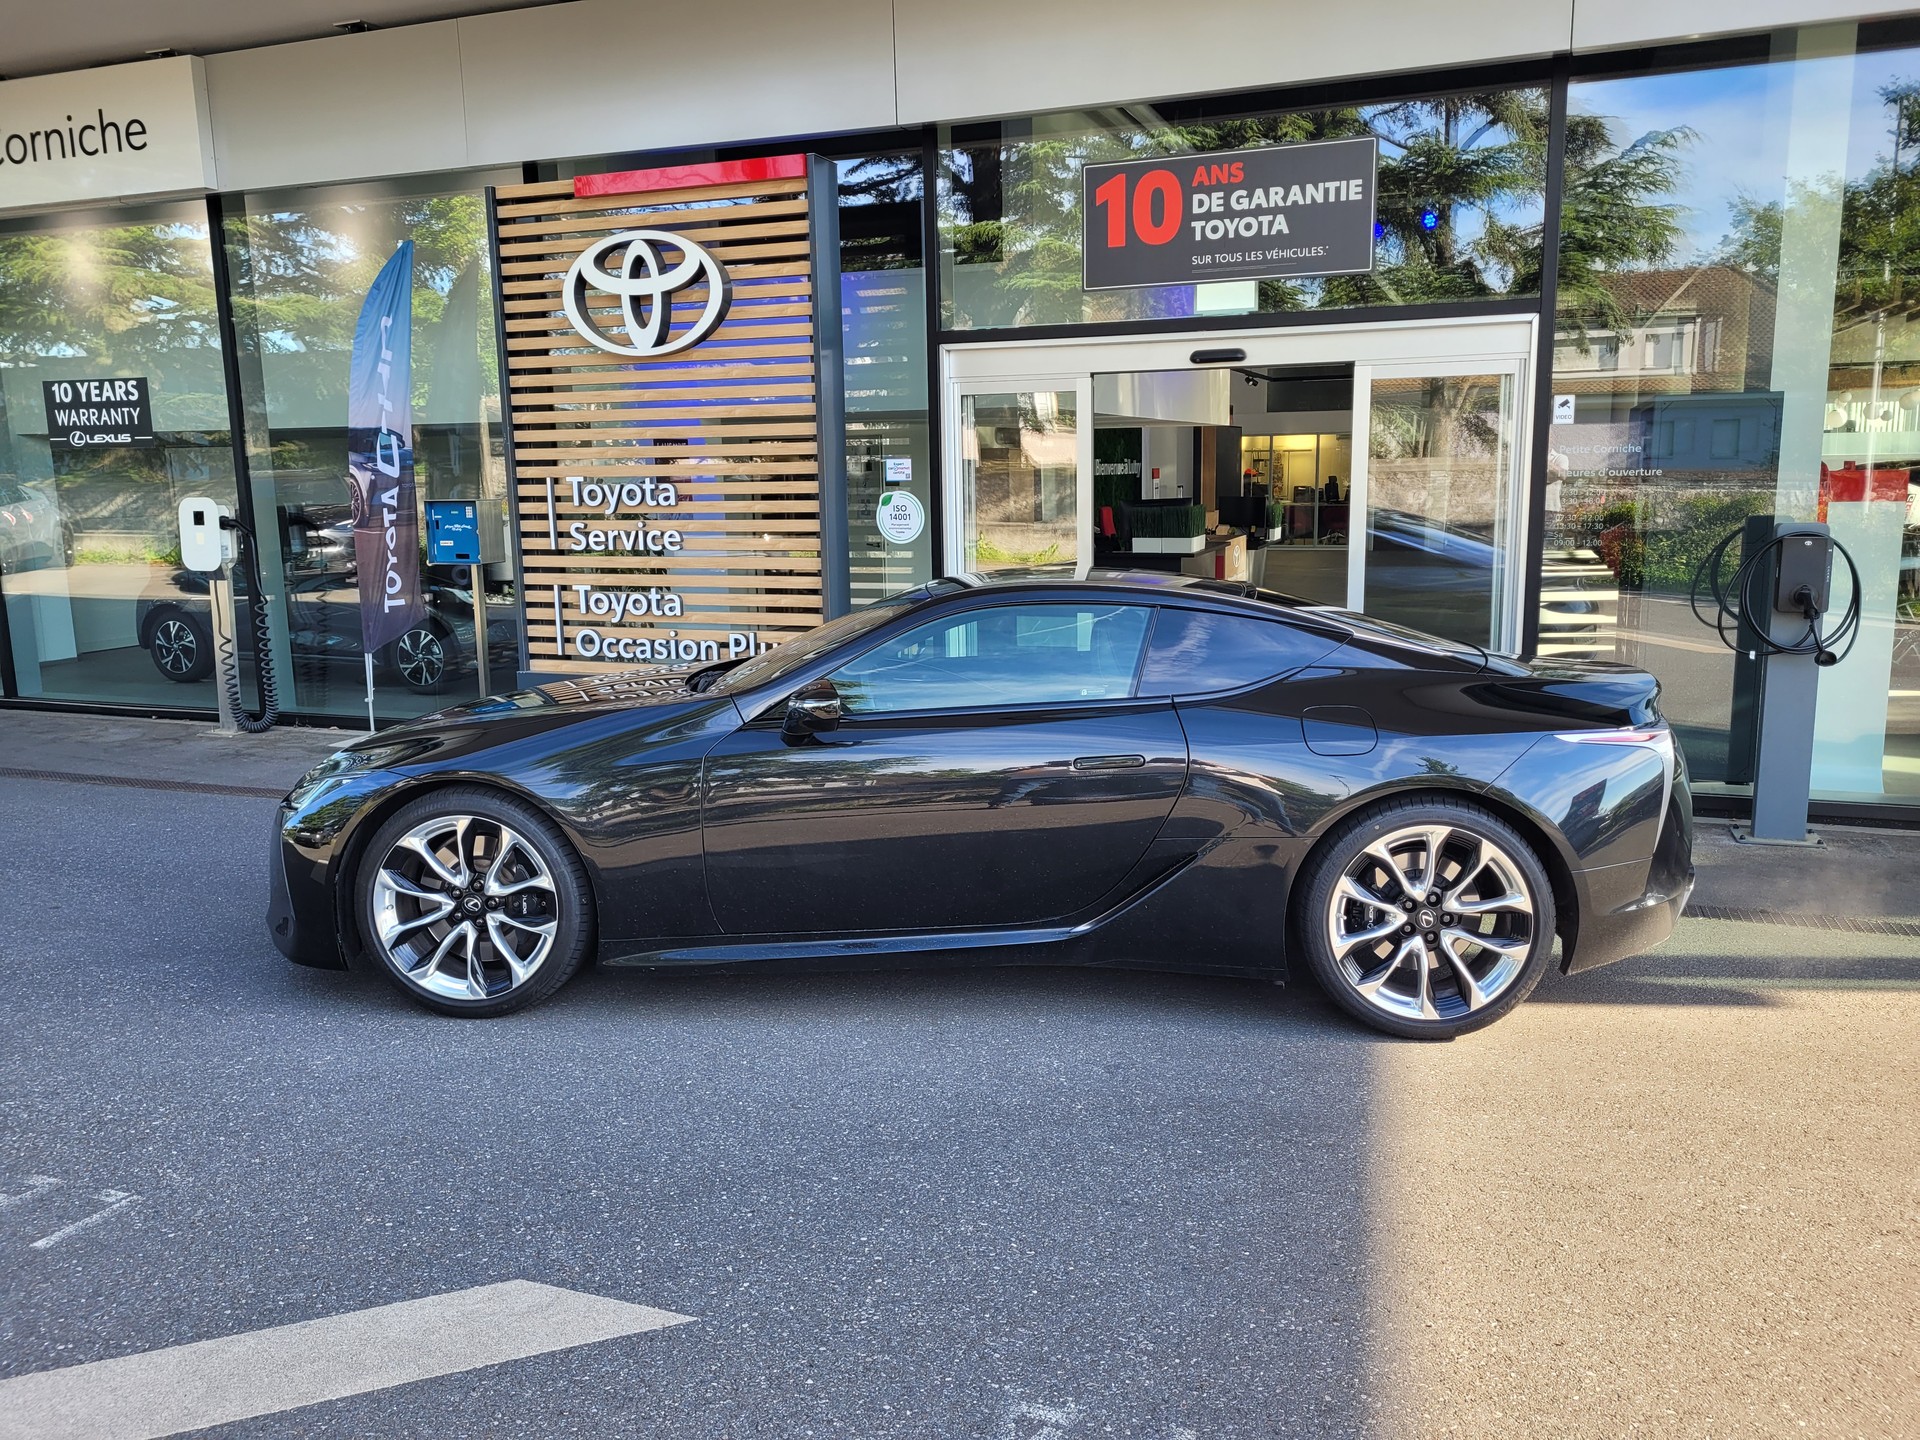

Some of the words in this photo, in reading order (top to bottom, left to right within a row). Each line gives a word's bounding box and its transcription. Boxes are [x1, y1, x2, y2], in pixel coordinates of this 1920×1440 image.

[0, 109, 147, 165] orniche
[1095, 169, 1183, 248] 10
[1192, 162, 1244, 187] ANS
[1192, 192, 1224, 214] DE
[1230, 179, 1363, 208] GARANTIE
[1191, 214, 1290, 241] TOYOTA
[1191, 255, 1212, 265] SUR
[1215, 253, 1242, 263] TOUS
[1245, 251, 1263, 261] LES
[51, 382, 72, 403] 10
[75, 380, 139, 402] YEARS
[54, 407, 140, 426] WARRANTY
[86, 433, 132, 444] LEXUS
[1559, 445, 1591, 454] Petite
[1593, 443, 1642, 453] Corniche
[1598, 467, 1663, 477] d'ouverture
[565, 476, 677, 515] Toyota
[889, 513, 911, 521] 14001
[892, 504, 908, 512] ISO
[569, 521, 683, 551] Service
[1584, 522, 1604, 530] 17:30
[381, 485, 406, 614] TOYOTA
[1553, 539, 1575, 547] 09:00
[1583, 539, 1603, 547] 12:00
[571, 585, 683, 624] Toyota
[575, 629, 720, 661] Occasion
[728, 632, 778, 659] Pl
